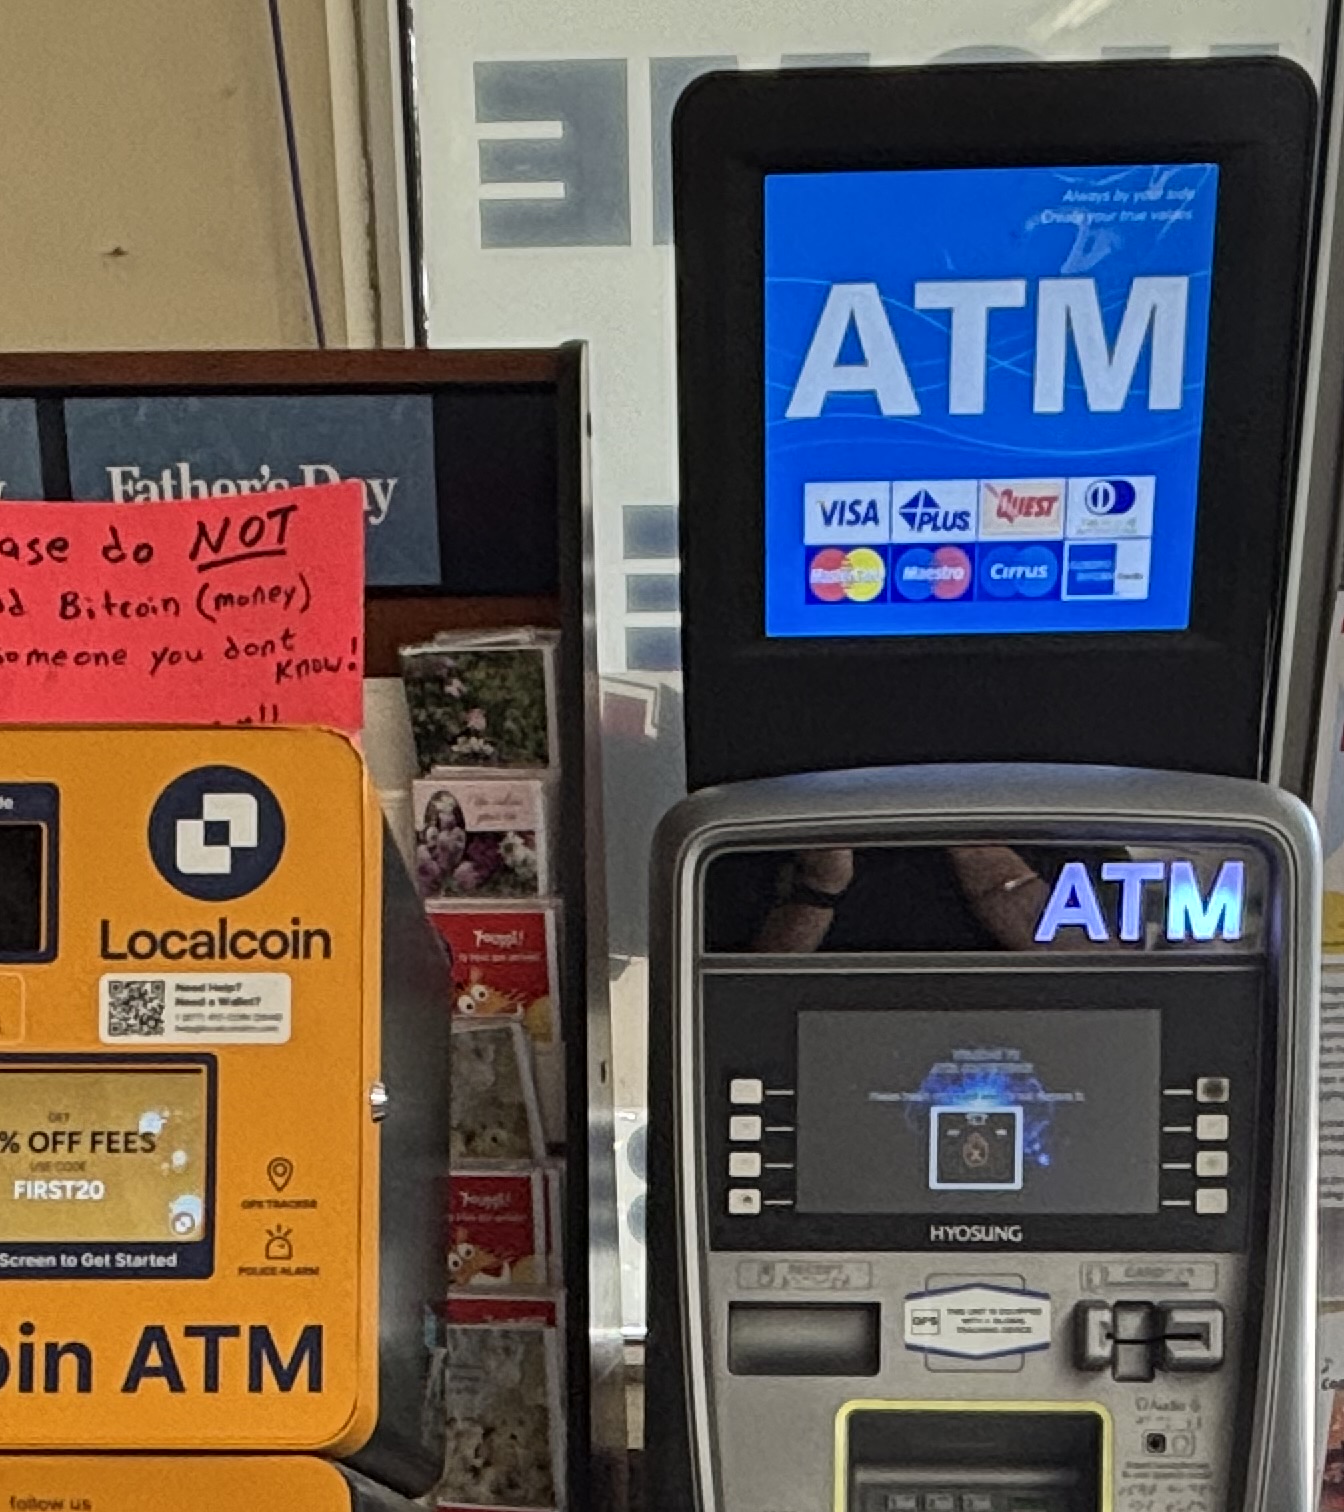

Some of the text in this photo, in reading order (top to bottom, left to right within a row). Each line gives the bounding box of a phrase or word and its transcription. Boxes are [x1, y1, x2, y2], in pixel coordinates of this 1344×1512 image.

[785, 276, 1189, 419] ATM
[820, 499, 881, 528] VISA
[919, 510, 972, 533] PLUS
[102, 525, 154, 565] do
[189, 504, 298, 562] NOT
[902, 566, 965, 581] Maestro
[989, 563, 1048, 581] Cirrus
[59, 591, 180, 621] Bitcoin
[196, 572, 312, 623] (money)
[150, 647, 204, 676] you
[1035, 861, 1244, 943] ATM
[100, 917, 333, 962] Localcoin
[28, 1131, 84, 1155] OFF
[90, 1130, 157, 1155] FEES
[12, 1180, 106, 1202] FIRST20
[929, 1223, 1023, 1244] HYOSUNG
[59, 1251, 79, 1269] to
[81, 1251, 112, 1269] Get
[114, 1251, 178, 1269] Started
[121, 1324, 325, 1395] ATM
[10, 1495, 92, 1511] follow us
